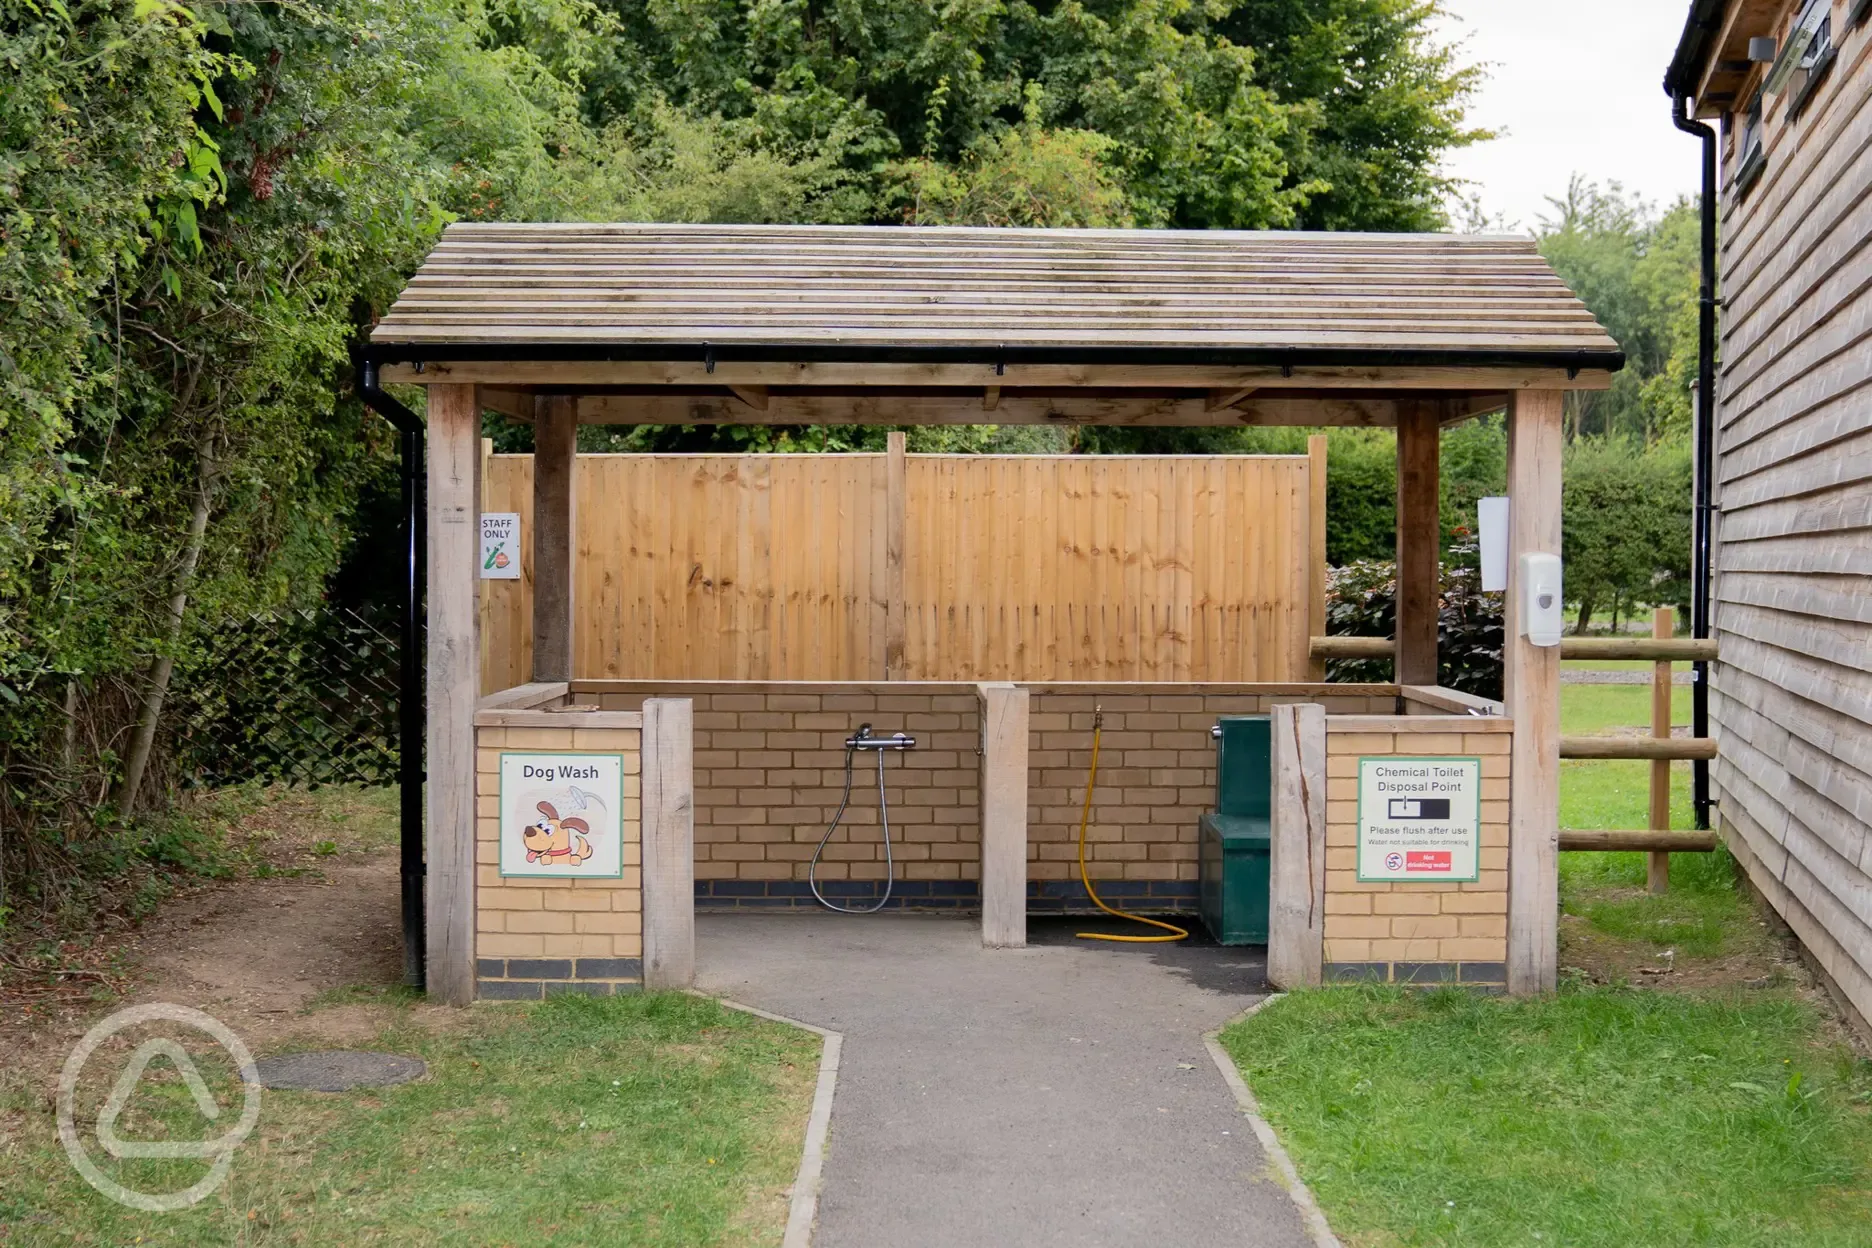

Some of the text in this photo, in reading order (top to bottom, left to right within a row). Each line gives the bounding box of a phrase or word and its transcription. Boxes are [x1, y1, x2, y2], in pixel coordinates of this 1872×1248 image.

[482, 519, 512, 528] STAFF
[484, 529, 510, 538] ONLY
[523, 765, 599, 781] Dog Wash
[1375, 767, 1464, 777] Chemical Toilet
[1378, 781, 1462, 793] Disposal Point
[1370, 826, 1468, 835] Please flush after use
